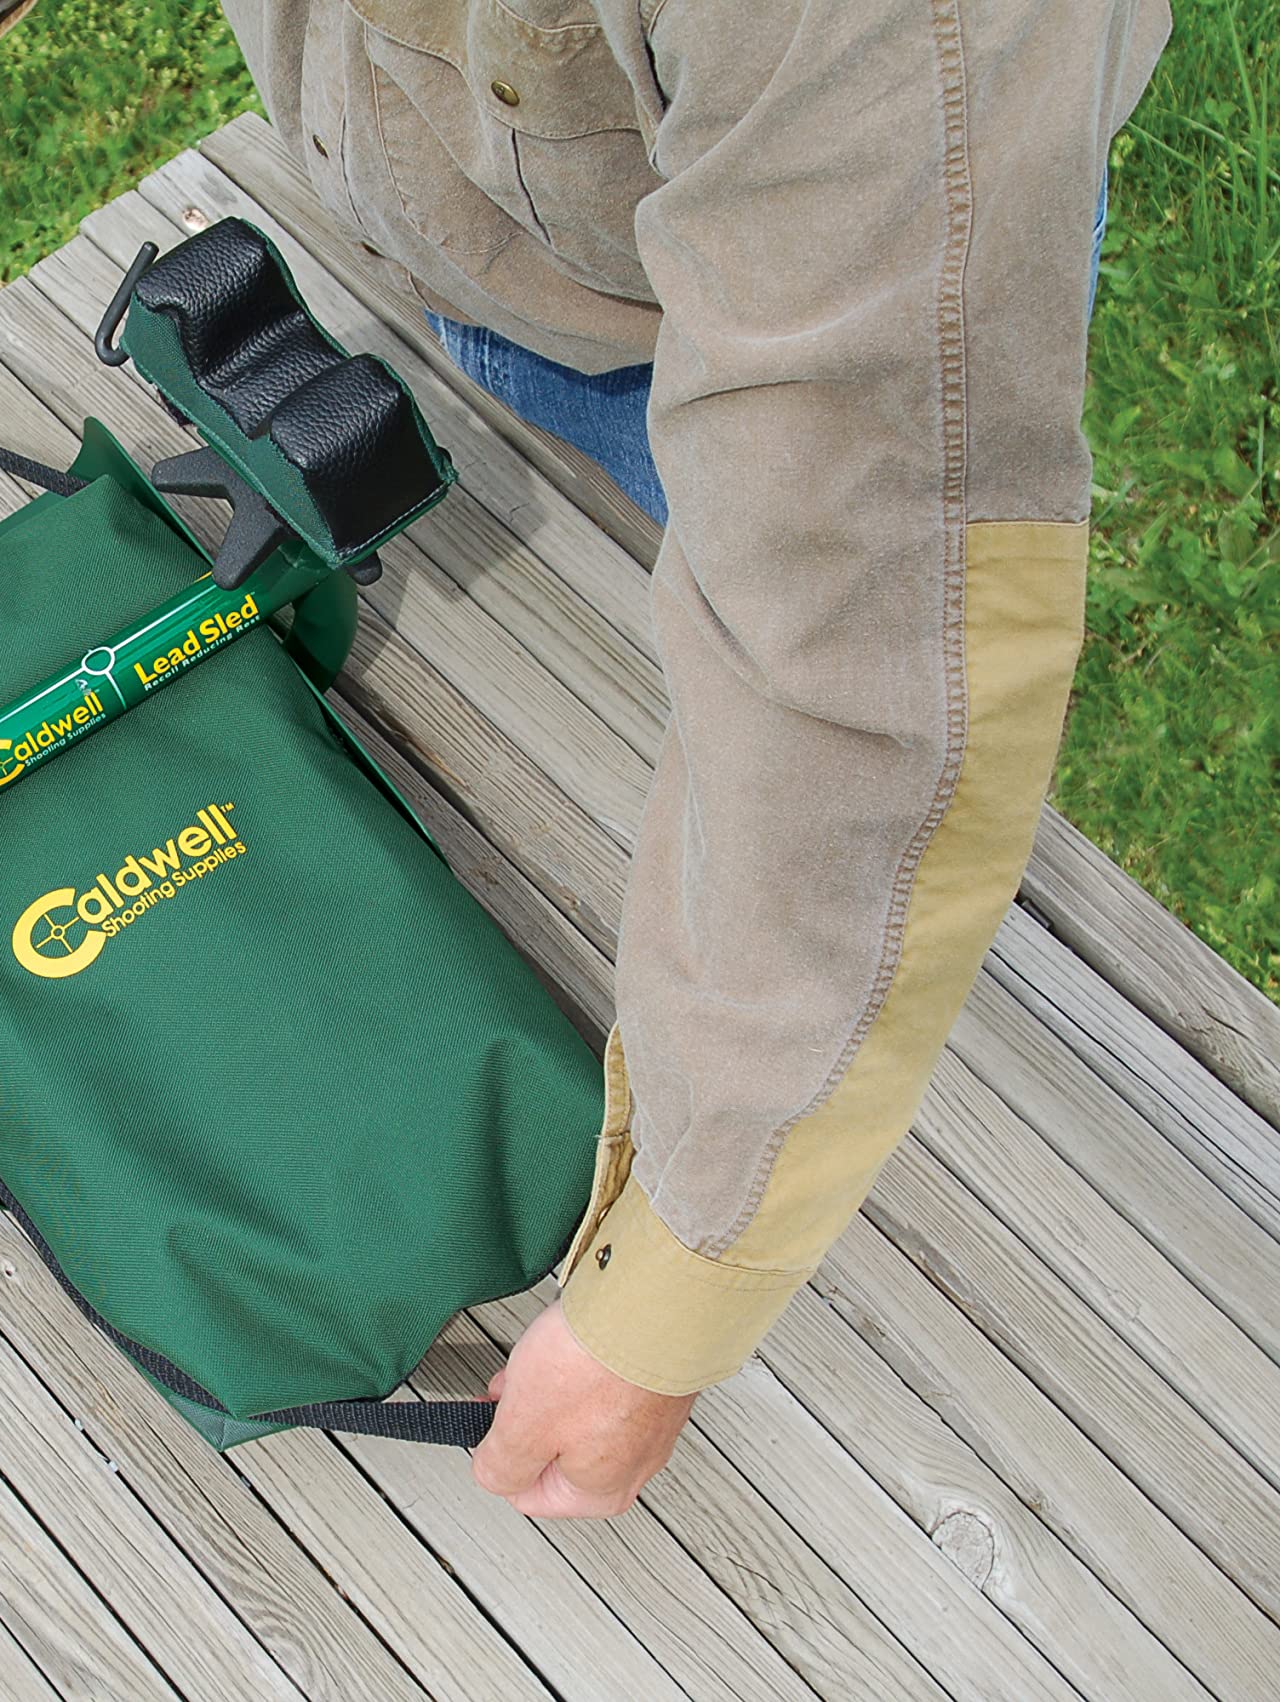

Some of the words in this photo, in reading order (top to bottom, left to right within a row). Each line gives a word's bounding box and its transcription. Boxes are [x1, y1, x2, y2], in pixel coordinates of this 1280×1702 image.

[133, 630, 202, 685] Lead
[199, 593, 260, 644] Sled
[144, 665, 180, 691] Recoil
[182, 632, 234, 667] Reducing
[235, 614, 261, 633] Rest
[24, 738, 66, 767] Shooting
[66, 712, 107, 740] Supplies
[11, 803, 238, 979] Caldwell
[100, 880, 176, 938] Shooting
[171, 841, 248, 888] Supplies
